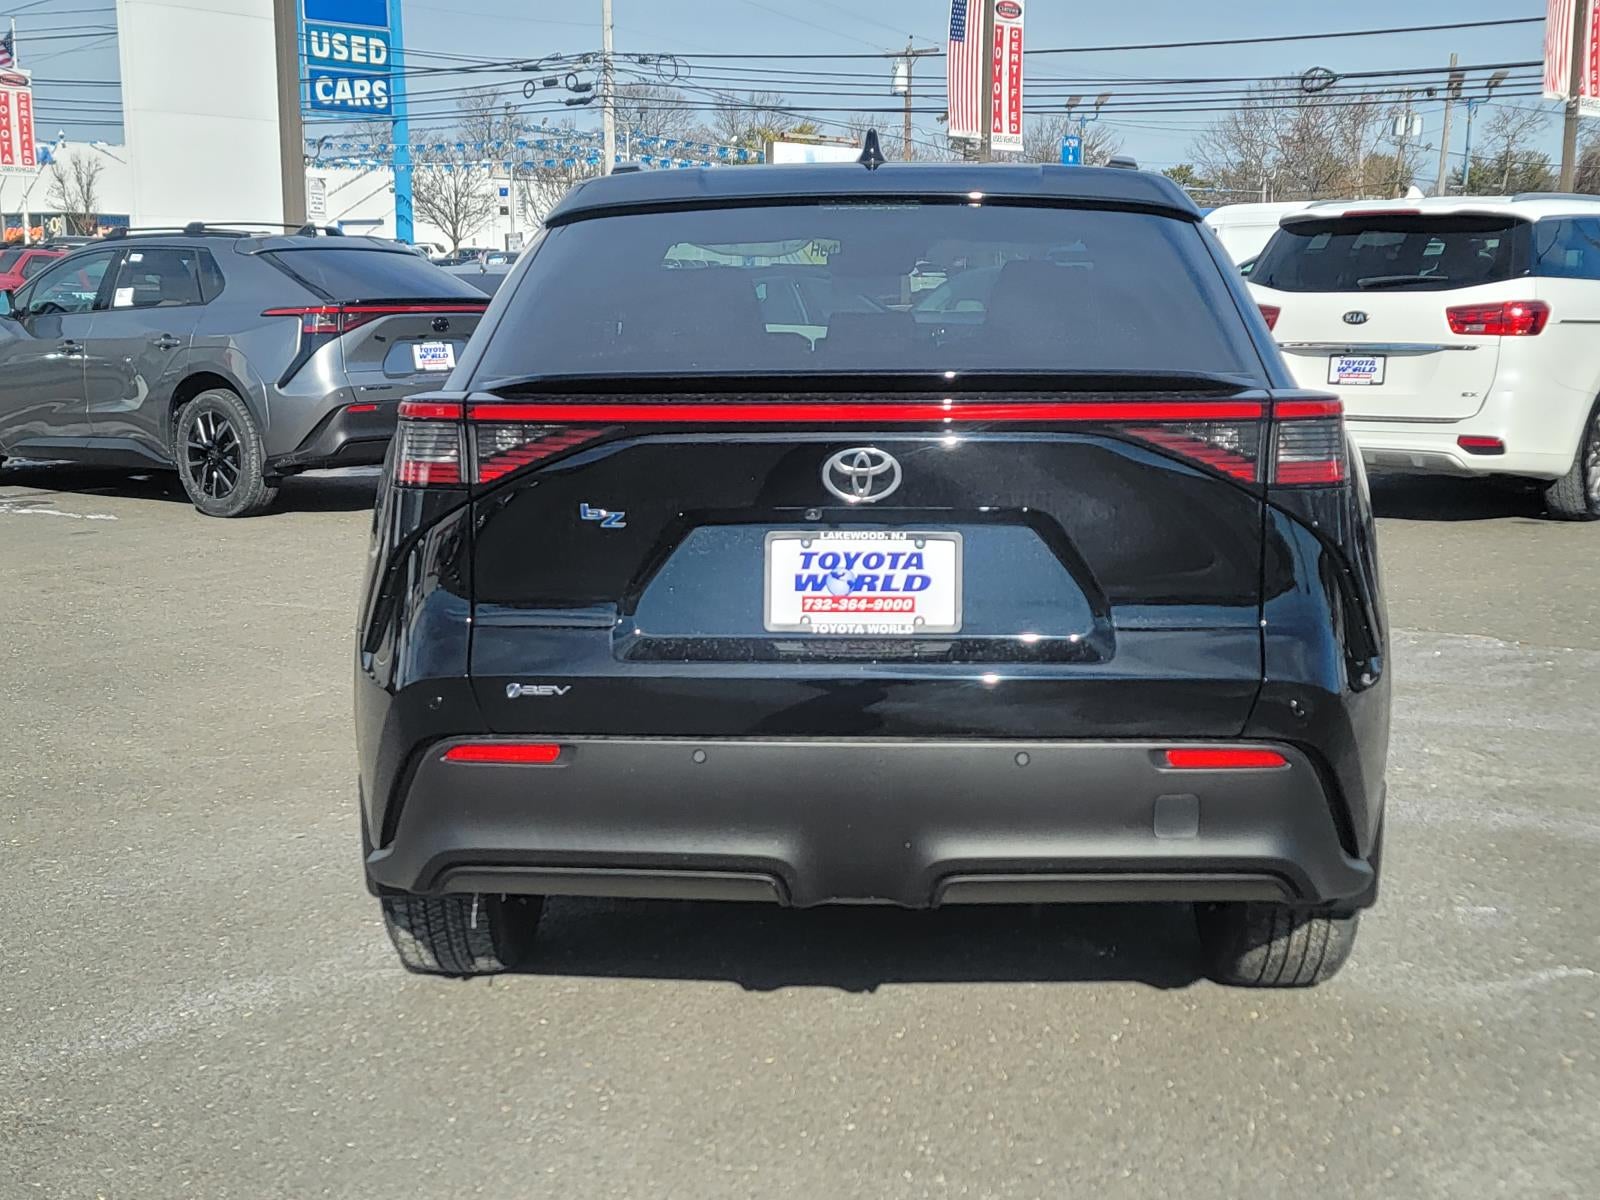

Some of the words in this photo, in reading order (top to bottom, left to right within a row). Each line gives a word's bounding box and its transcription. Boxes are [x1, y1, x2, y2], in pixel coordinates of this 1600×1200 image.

[311, 30, 387, 65] USED
[315, 75, 388, 109] CARS
[993, 28, 1002, 131] TOYOTA
[1010, 29, 1020, 132] CERTIFIED
[0, 92, 13, 163] TOYOTA
[18, 93, 33, 164] CERTIFIED
[1345, 312, 1365, 322] KIA
[579, 502, 627, 529] bZ
[890, 531, 907, 541] NJ
[799, 551, 925, 570] TOYOTA
[803, 597, 913, 611] 732-364-9000
[811, 624, 864, 634] TOYOTA
[867, 624, 915, 635] WORLD
